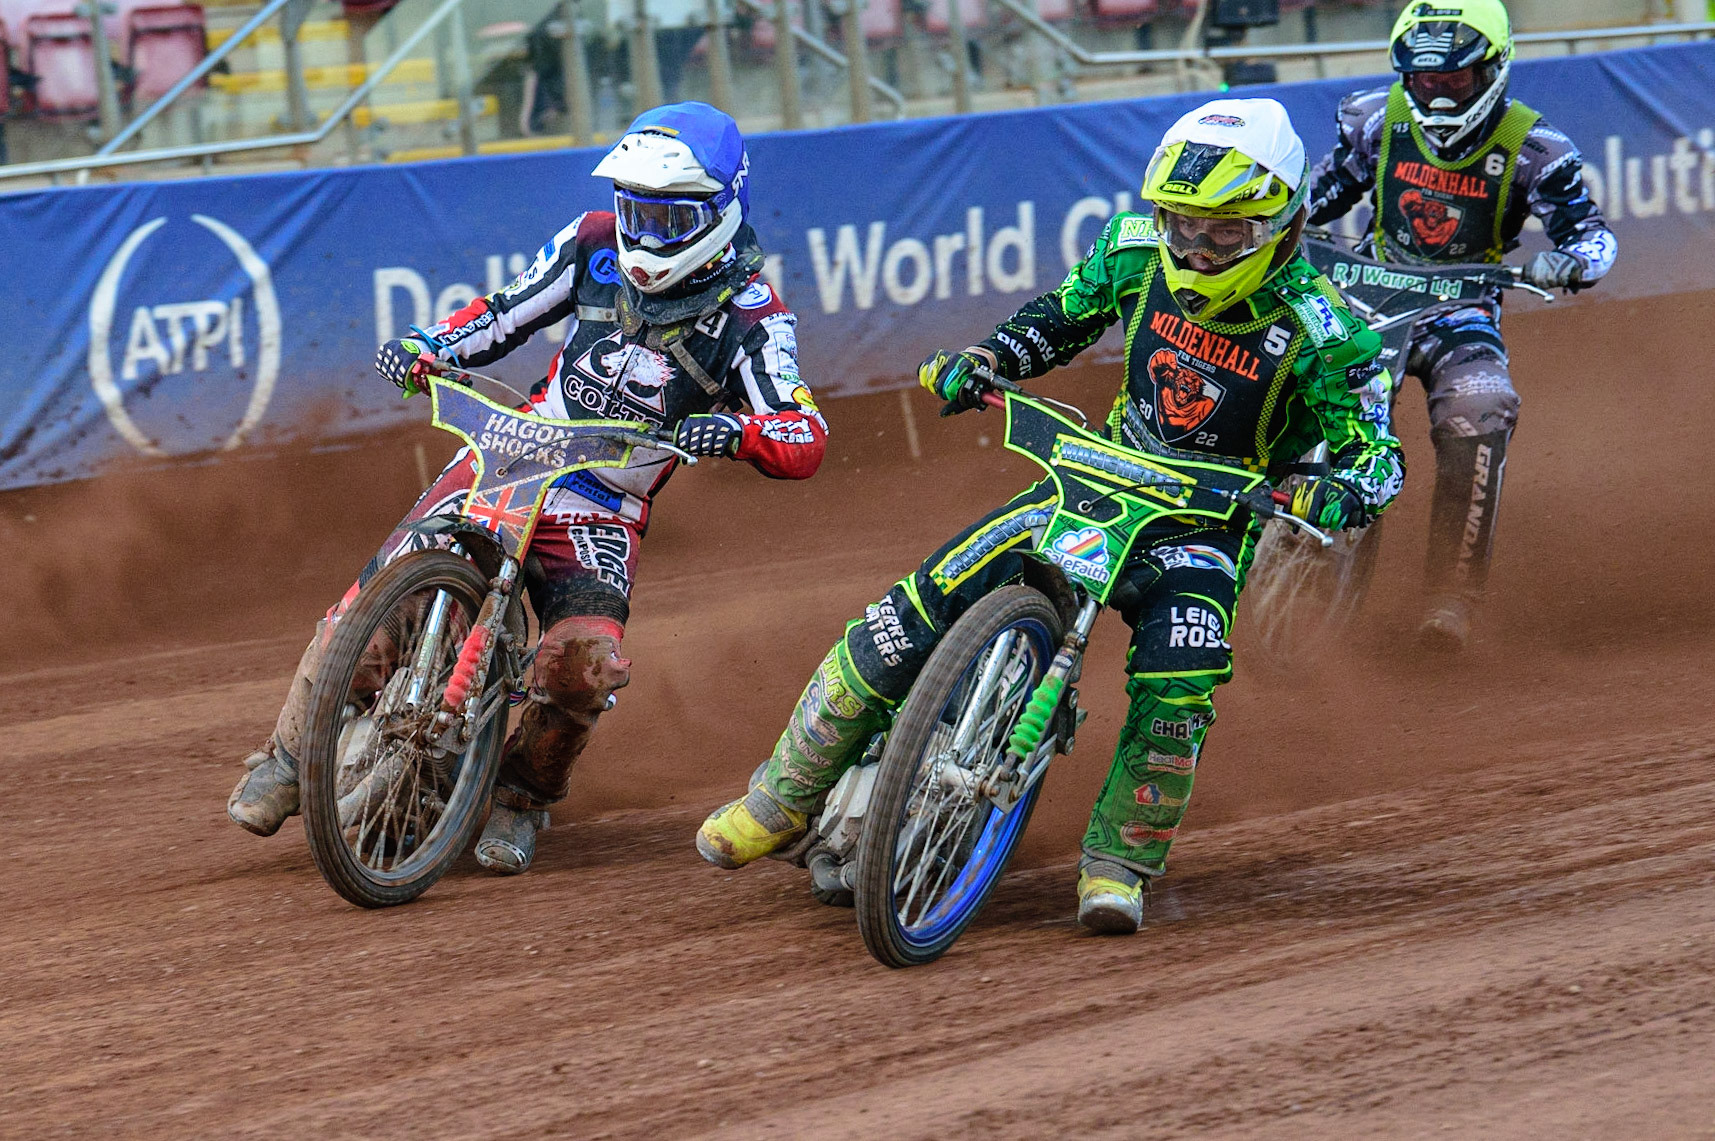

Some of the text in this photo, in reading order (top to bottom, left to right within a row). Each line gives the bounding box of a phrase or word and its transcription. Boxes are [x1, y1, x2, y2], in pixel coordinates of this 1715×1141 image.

[1393, 161, 1489, 199] MILDENHALL
[1484, 152, 1506, 176] 6
[1162, 182, 1194, 195] BELL
[1396, 229, 1411, 246] 20
[1448, 243, 1467, 255] 22
[807, 199, 1036, 315] World
[1332, 262, 1463, 299] R J Warren Ltd
[702, 310, 723, 335] 4
[1316, 297, 1334, 336] FRL
[122, 296, 244, 380] ATPI
[1149, 310, 1261, 382] MILDENHALL
[1263, 324, 1292, 356] 5
[1177, 349, 1217, 375] FEN TIGERS
[1138, 397, 1154, 421] 20
[484, 413, 575, 449] HAGON
[1194, 431, 1219, 447] 22
[478, 431, 568, 469] SHOCKS
[572, 479, 613, 503] rental
[587, 523, 630, 597] EDGE
[879, 594, 914, 651] TERRY
